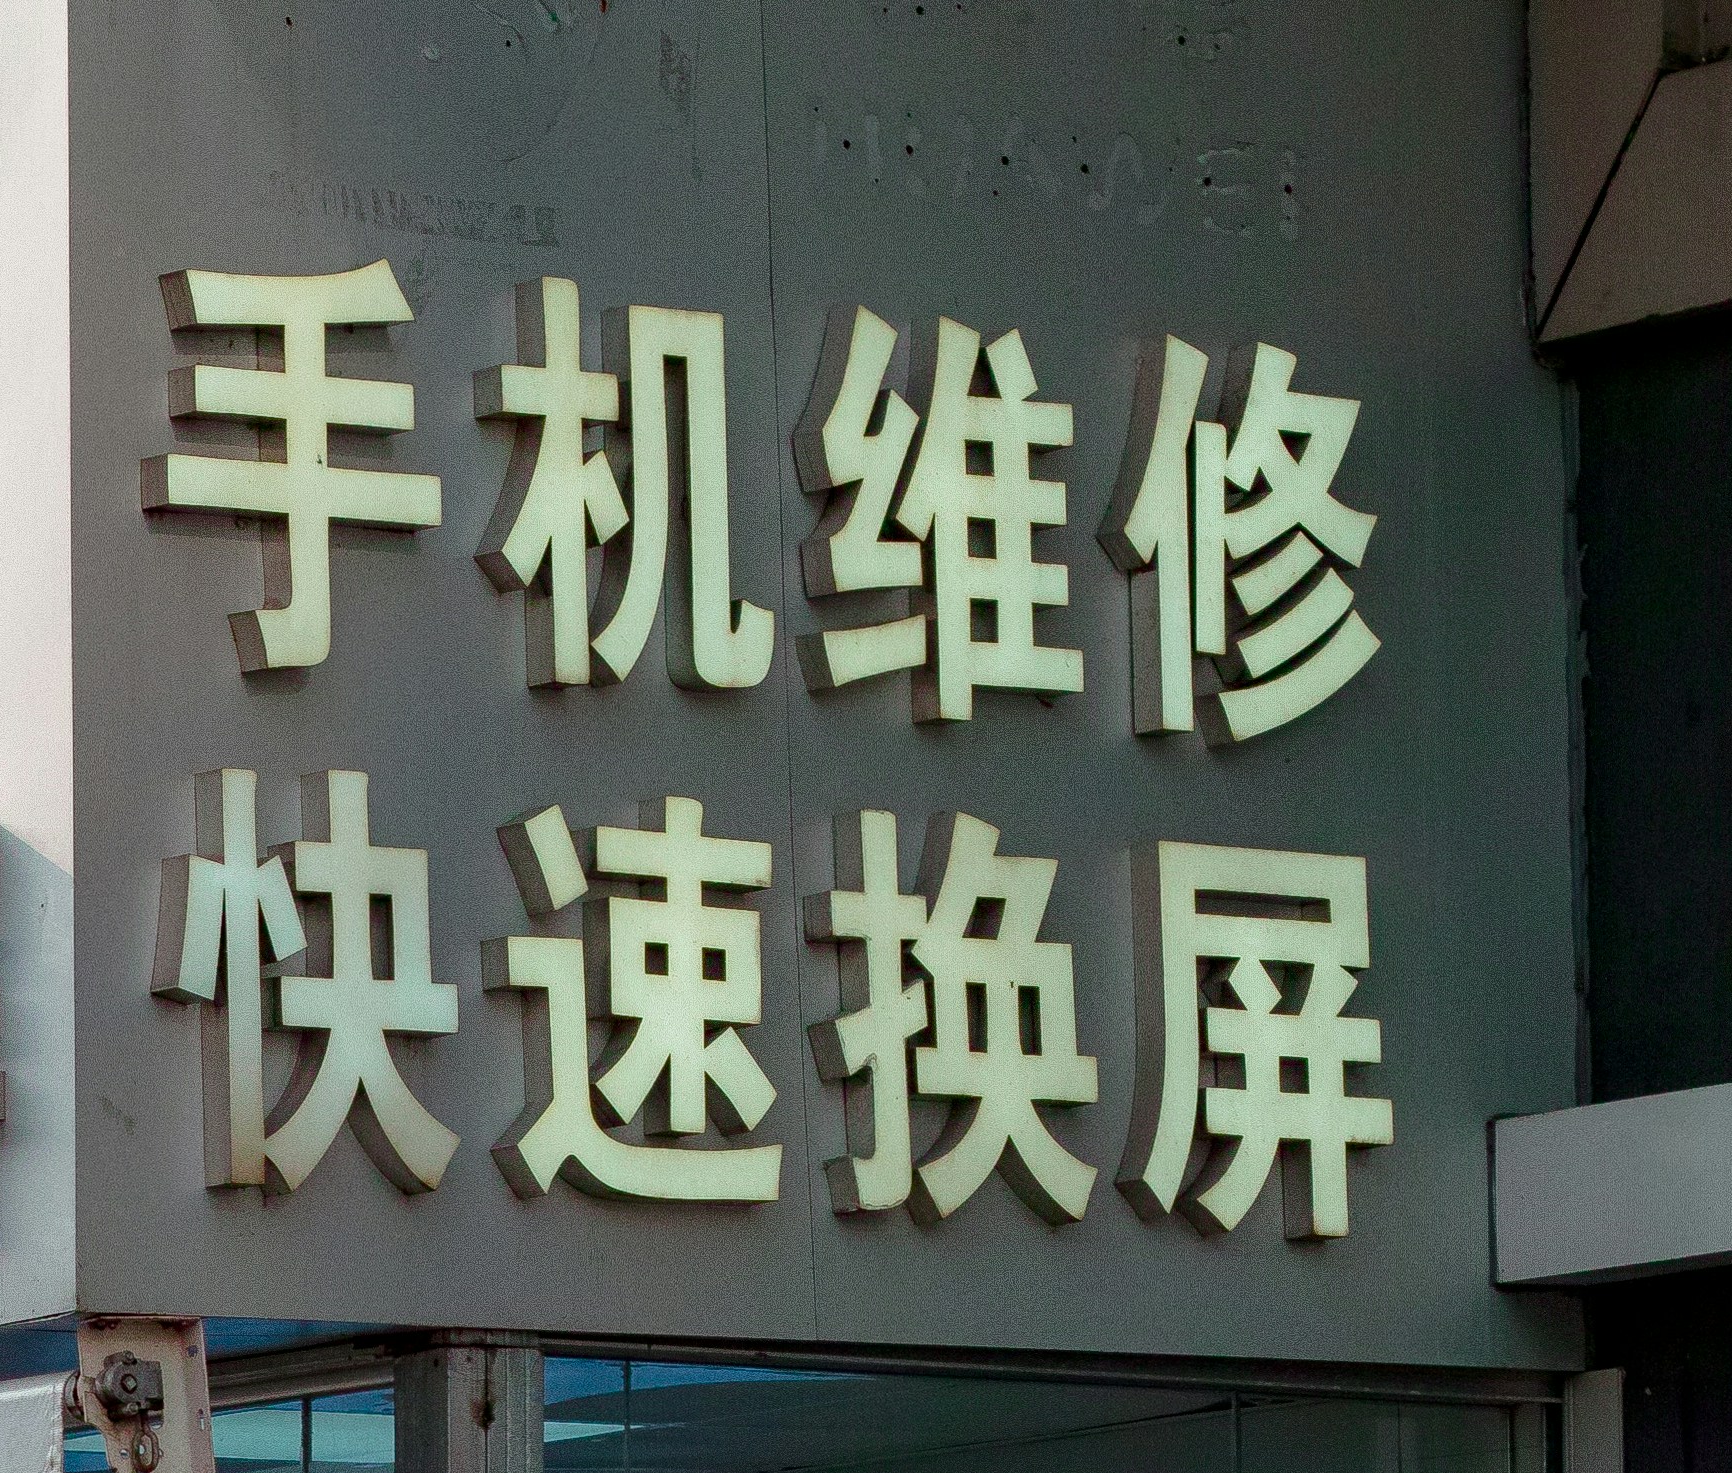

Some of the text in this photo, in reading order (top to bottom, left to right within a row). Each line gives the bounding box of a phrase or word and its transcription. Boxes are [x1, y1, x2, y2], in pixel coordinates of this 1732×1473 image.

[142, 258, 1381, 746] 手机维修
[152, 768, 1394, 1240] 快速换屏
